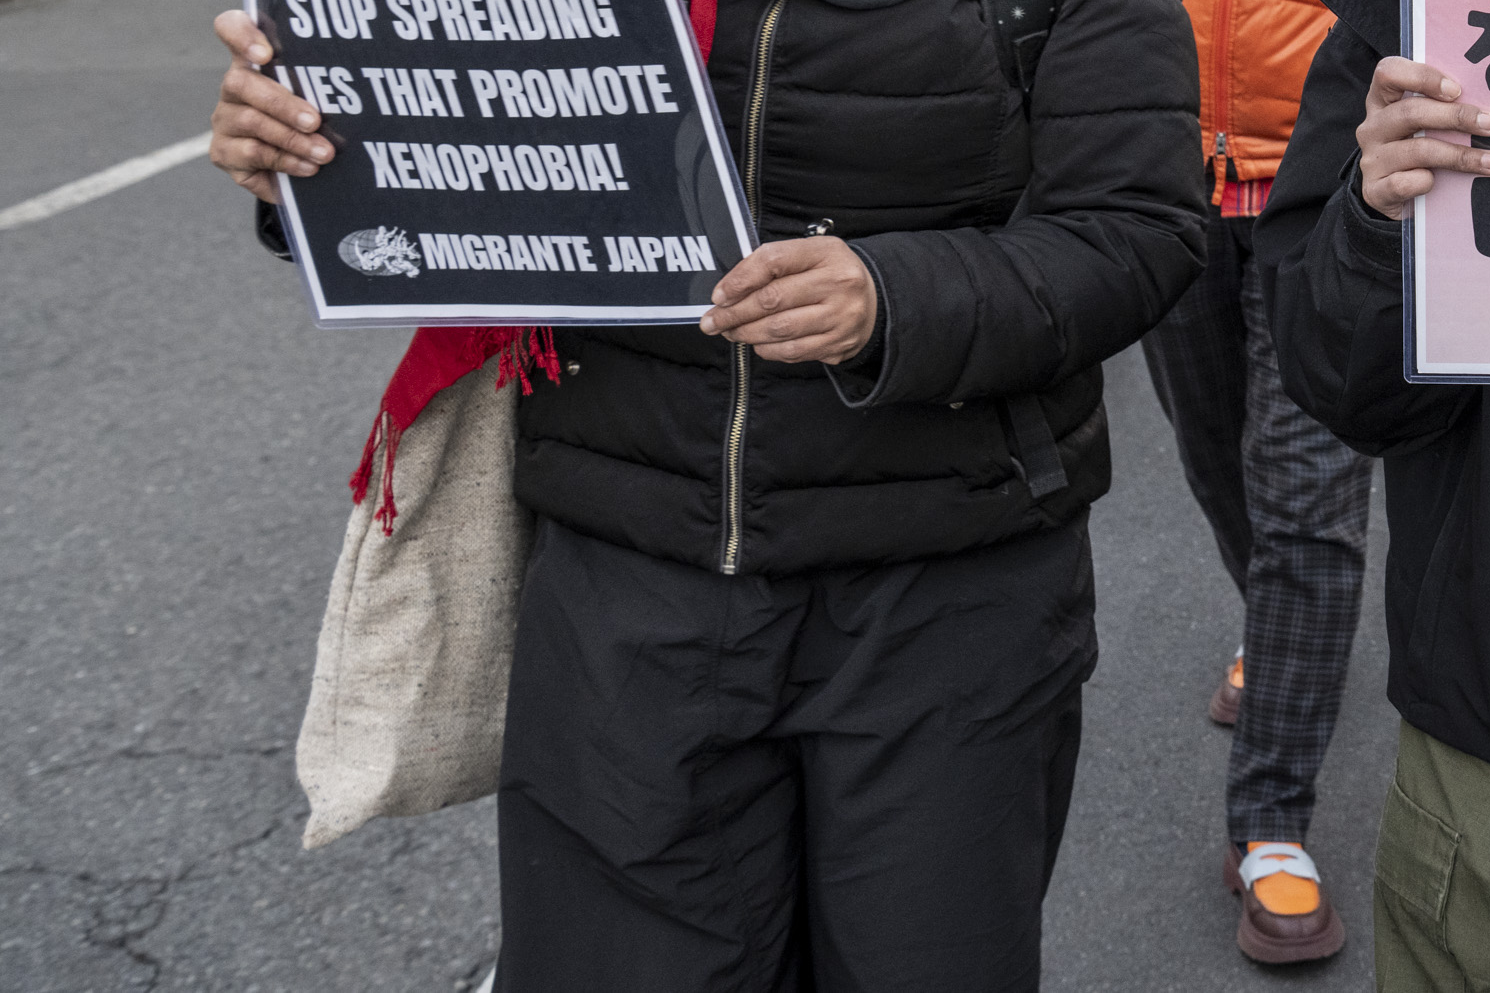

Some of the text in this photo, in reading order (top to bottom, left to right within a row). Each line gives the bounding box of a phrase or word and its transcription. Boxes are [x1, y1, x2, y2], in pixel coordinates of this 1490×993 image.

[361, 67, 465, 117] THAT
[467, 64, 680, 118] PROMOTE
[362, 141, 630, 191] XENOPHOBIA!
[419, 233, 716, 273] MIGRANTE JAPAN
